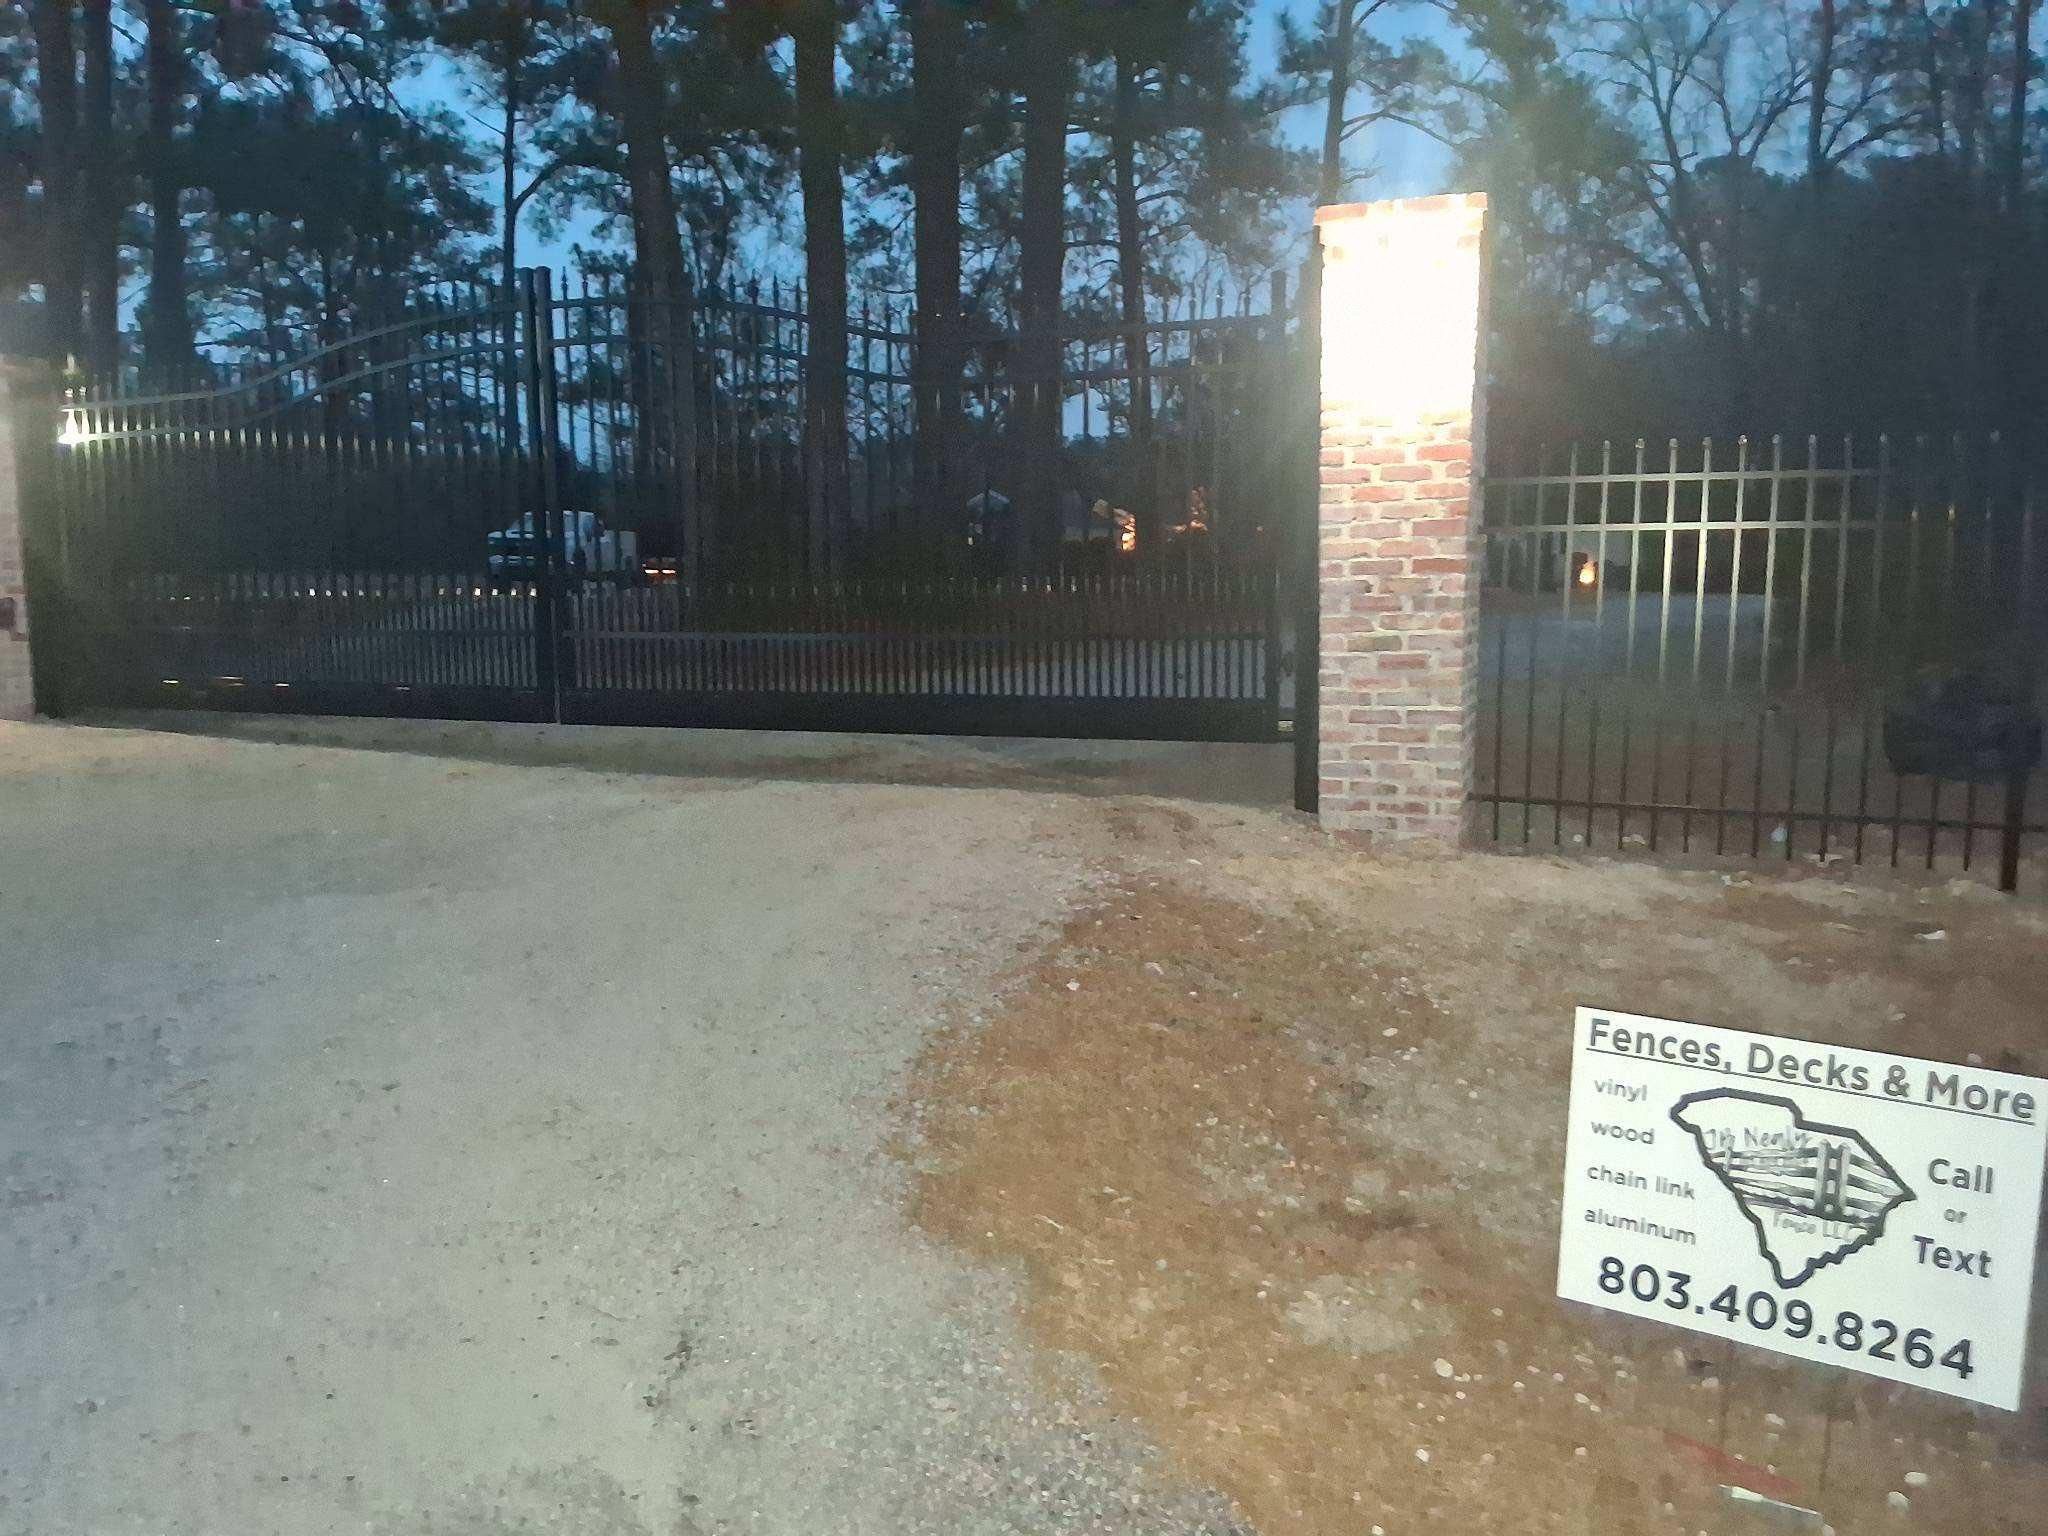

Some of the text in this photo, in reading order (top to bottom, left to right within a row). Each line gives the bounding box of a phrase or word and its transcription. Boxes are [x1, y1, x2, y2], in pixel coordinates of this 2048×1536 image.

[1590, 1017, 2035, 1119] Fences, Decks & More
[1594, 1078, 1648, 1102] vinyl
[1591, 1121, 1655, 1145] wood
[1587, 1165, 1695, 1200] chain link
[1928, 1158, 1993, 1194] Call
[1584, 1208, 1697, 1246] aluminum
[1943, 1208, 1968, 1223] or
[1912, 1234, 1992, 1279] Text
[1599, 1256, 1974, 1379] 803.409.8264
